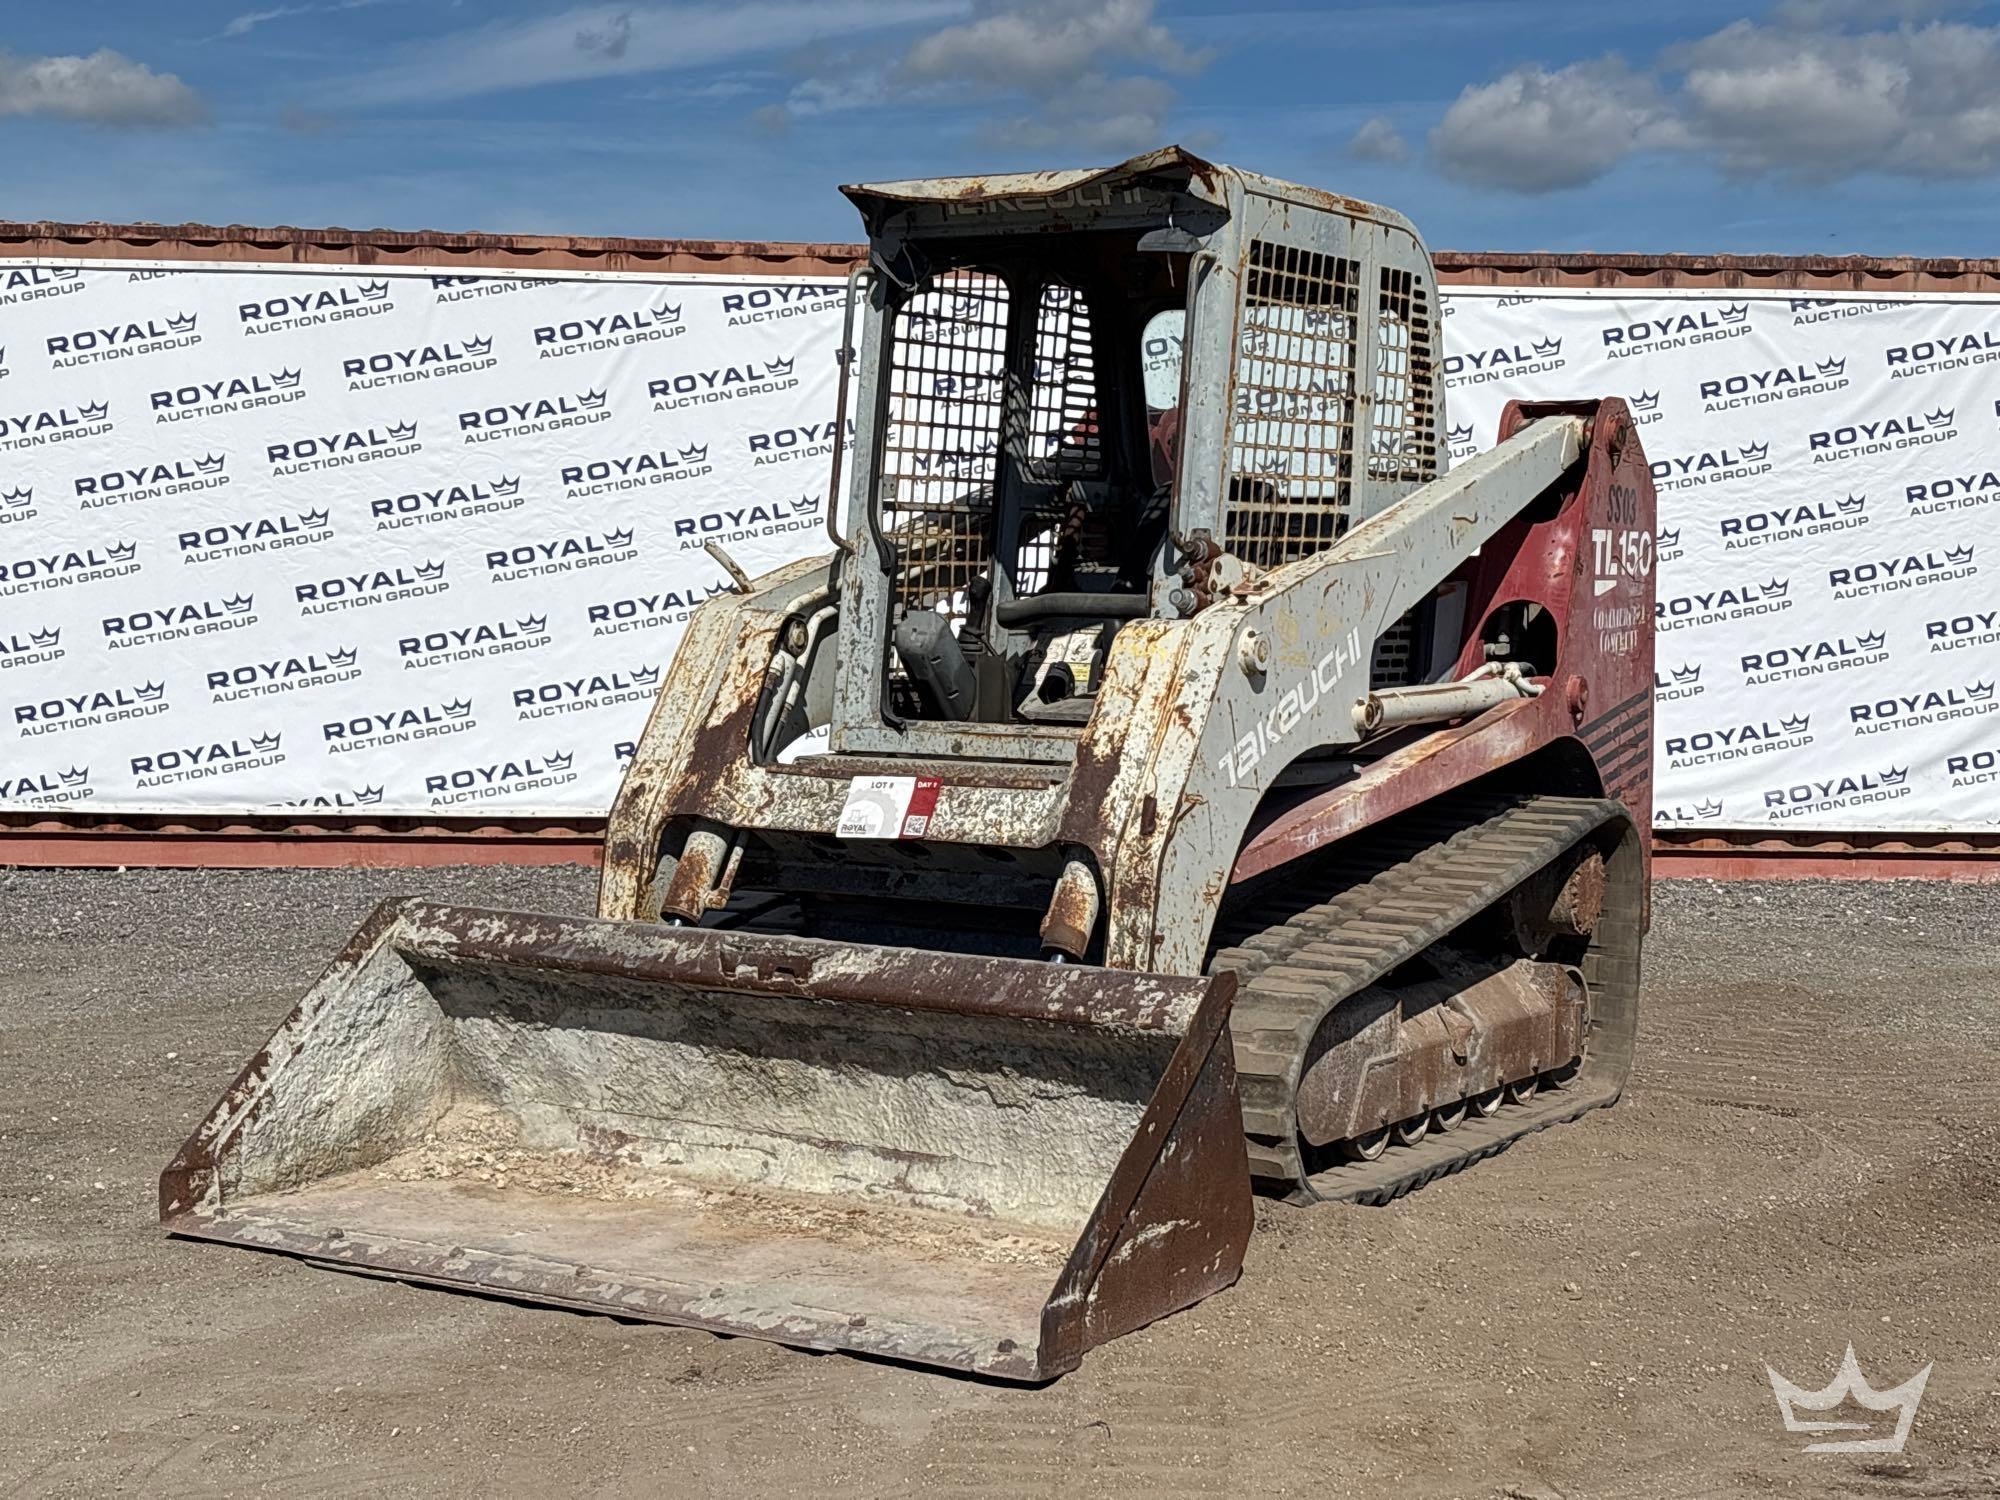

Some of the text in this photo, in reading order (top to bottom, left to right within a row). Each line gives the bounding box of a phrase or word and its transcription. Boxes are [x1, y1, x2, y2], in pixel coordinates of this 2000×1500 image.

[21, 282, 85, 301] GROUP
[239, 288, 360, 322] ROYAL
[436, 282, 517, 304] AUCTION
[245, 302, 394, 336] AUCTION GROUP
[534, 312, 652, 346] ROYAL
[728, 305, 807, 327] AUCTION
[1602, 312, 1719, 346] ROYAL
[1793, 304, 1872, 326] AUCTION
[46, 320, 167, 355] ROYAL
[52, 335, 202, 369] AUCTION GROUP
[540, 326, 686, 359] AUCTION GROUP
[1607, 326, 1752, 360] AUCTION GROUP
[1886, 331, 2000, 366] ROYAL
[343, 344, 463, 378] ROYAL
[349, 358, 497, 391] AUCTION GROUP
[1443, 345, 1532, 374] OYAL
[1445, 359, 1565, 389] CTION GROUP
[1891, 357, 1969, 379] AUCTION
[150, 376, 271, 410] ROYAL
[648, 364, 765, 398] ROYAL
[654, 378, 798, 412] AUCTION GROUP
[1700, 365, 1816, 400] ROYAL
[1704, 379, 1849, 413] AUCTION GROUP
[0, 409, 78, 437] YAL
[156, 390, 306, 424] AUCTION GROUP
[458, 397, 578, 430] ROYAL
[0, 423, 113, 451] TION GROUP
[464, 411, 612, 444] AUCTION GROUP
[1809, 416, 1925, 451] ROYAL
[267, 429, 388, 463] ROYAL
[273, 444, 422, 477] AUCTION GROUP
[754, 444, 832, 466] AUCTION
[1813, 430, 1958, 464] AUCTION GROUP
[74, 462, 195, 496] ROYAL
[561, 451, 679, 485] ROYAL
[1649, 450, 1739, 478] OYAL
[1710, 464, 1772, 482] GROUP
[80, 476, 230, 510] AUCTION GROUP
[567, 465, 712, 499] AUCTION GROUP
[1906, 472, 2000, 504] ROYA
[371, 484, 490, 518] ROYAL
[377, 498, 524, 531] AUCTION GROUP
[1910, 494, 1988, 516] AUCTION
[178, 516, 300, 551] ROYAL
[674, 503, 791, 537] ROYAL
[680, 517, 824, 551] AUCTION GROUP
[1720, 502, 1836, 537] ROYAL
[1725, 516, 1869, 550] AUCTION GROUP
[184, 530, 334, 564] AUCTION GROUP
[486, 536, 604, 570] ROYAL
[77, 564, 141, 583] GROUP
[492, 550, 638, 583] AUCTION GROUP
[1829, 553, 1945, 587] ROYAL
[1834, 566, 1978, 600] AUCTION GROUP
[295, 568, 415, 603] ROYAL
[301, 582, 449, 616] AUCTION GROUP
[102, 602, 223, 636] ROYAL
[588, 589, 705, 623] ROYAL
[1730, 600, 1792, 619] GROUP
[108, 616, 258, 650] AUCTION GROUP
[398, 622, 518, 656] ROYAL
[594, 615, 672, 636] AUCTION
[1926, 611, 2000, 640] ROY
[1, 649, 65, 668] GROUP
[404, 636, 551, 670] AUCTION GROUP
[1741, 639, 1856, 673] ROYAL
[1746, 652, 1889, 686] AUCTION GROUP
[206, 656, 327, 690] ROYAL
[213, 669, 362, 703] AUCTION GROUP
[513, 673, 630, 707] ROYAL
[14, 689, 135, 724] ROYAL
[519, 698, 598, 720] AUCTION
[1218, 626, 1361, 788] TAKEUCHI
[1656, 686, 1704, 702] ROUP
[1850, 689, 1966, 723] ROYAL
[20, 703, 169, 738] AUCTION GROUP
[323, 706, 442, 741] ROYAL
[1855, 702, 1999, 736] AUCTION GROUP
[329, 720, 476, 754] AUCTION GROUP
[1666, 722, 1780, 756] ROYAL
[1670, 736, 1814, 769] AUCTION GROUP
[130, 740, 251, 775] ROYAL
[136, 754, 286, 788] AUCTION GROUP
[425, 759, 544, 794] ROYAL
[431, 773, 577, 806] AUCTION GROUP
[871, 781, 888, 789] LOT
[917, 781, 932, 789] DAY
[1764, 774, 1878, 808] ROYAL
[1768, 787, 1911, 820] AUCTION GROUP
[841, 824, 866, 832] ROYAL
